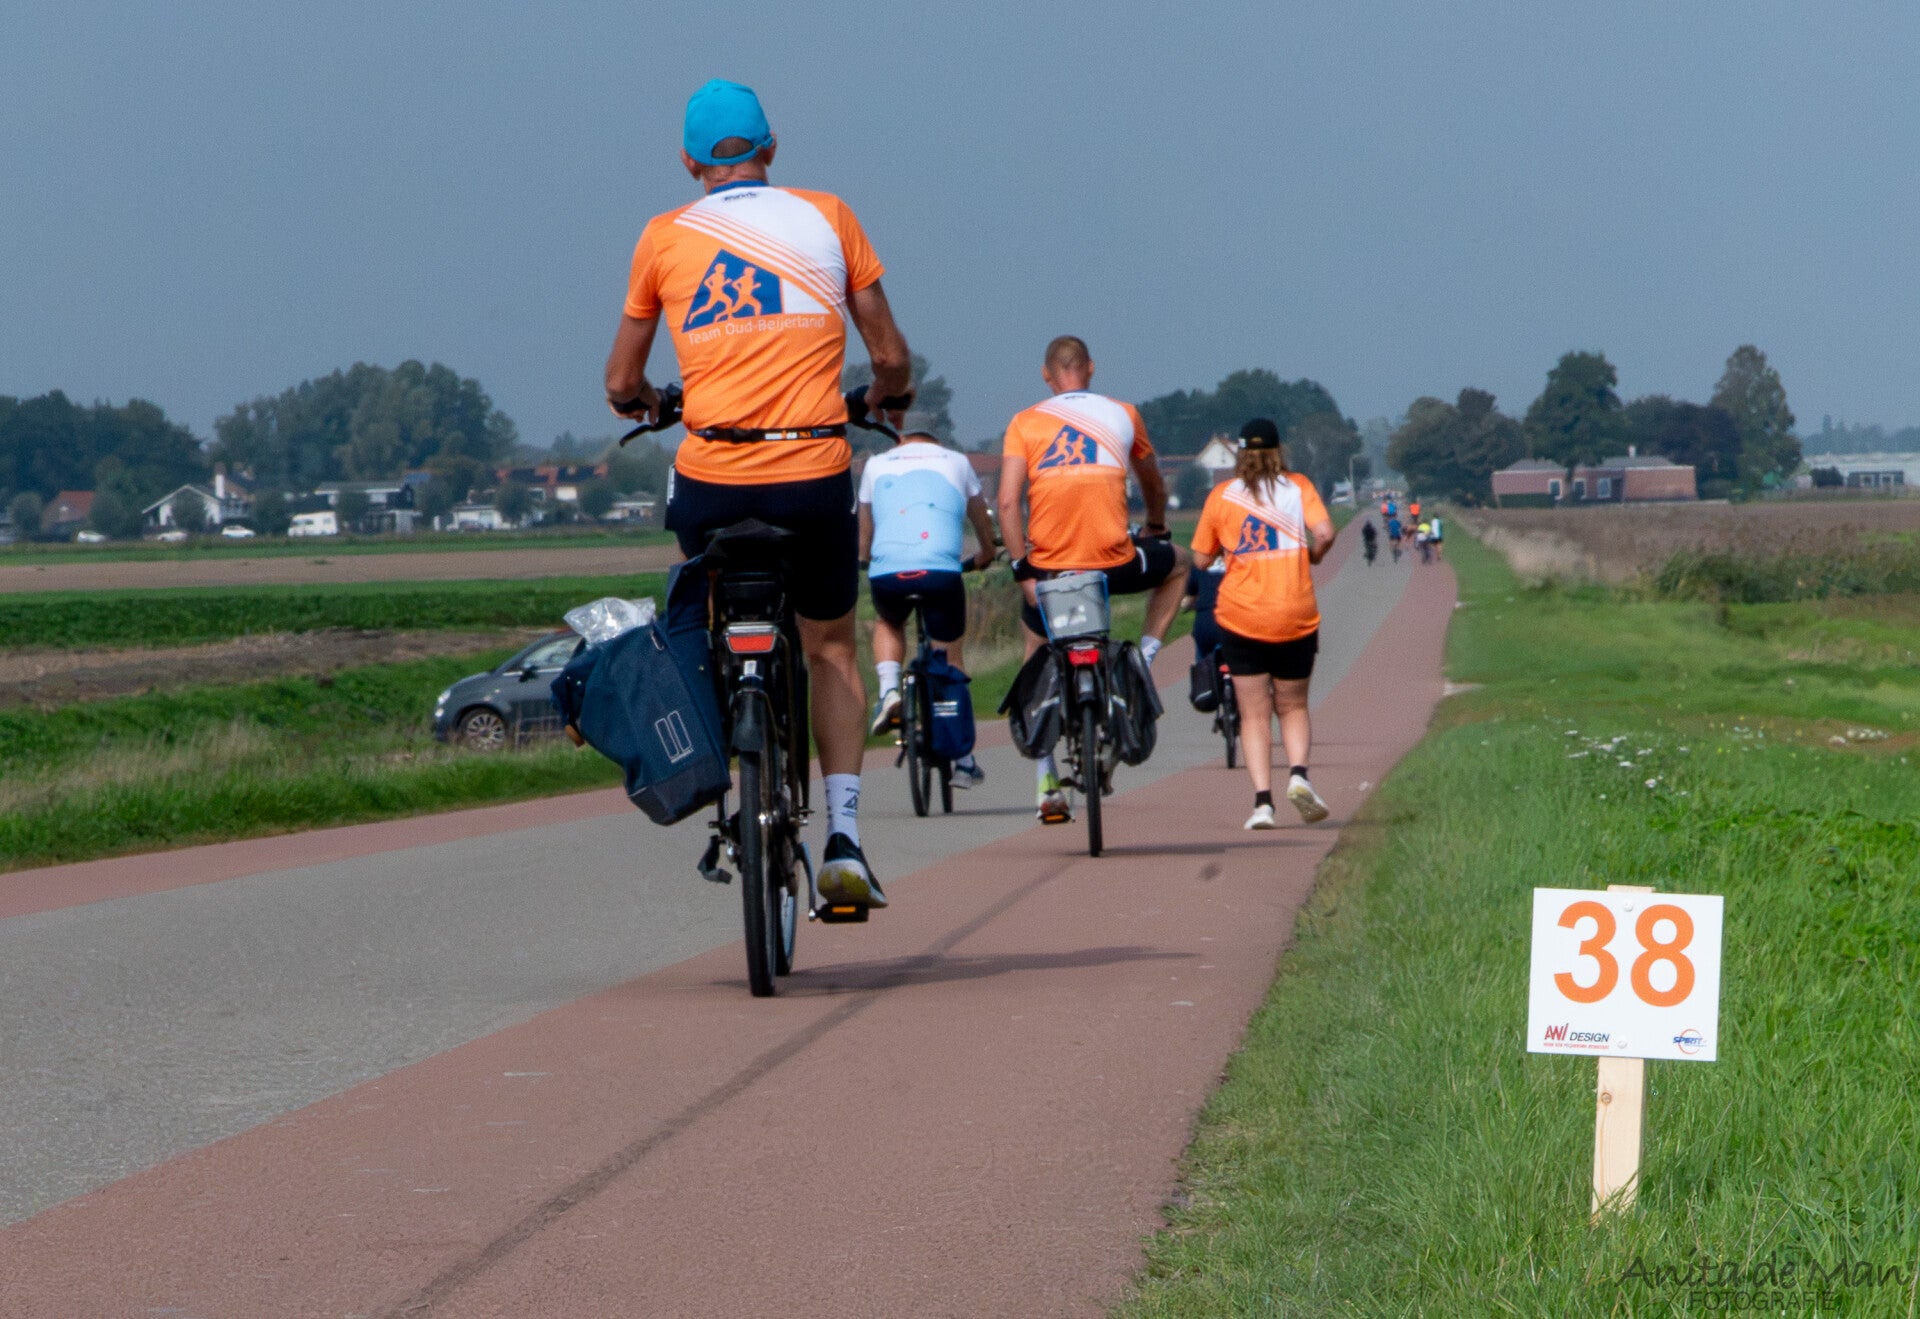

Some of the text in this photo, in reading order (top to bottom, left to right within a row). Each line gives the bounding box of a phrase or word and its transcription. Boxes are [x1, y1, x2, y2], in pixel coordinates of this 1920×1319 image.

[688, 329, 721, 345] Team
[1553, 900, 1695, 1007] 38
[1569, 1031, 1610, 1043] DESIGN
